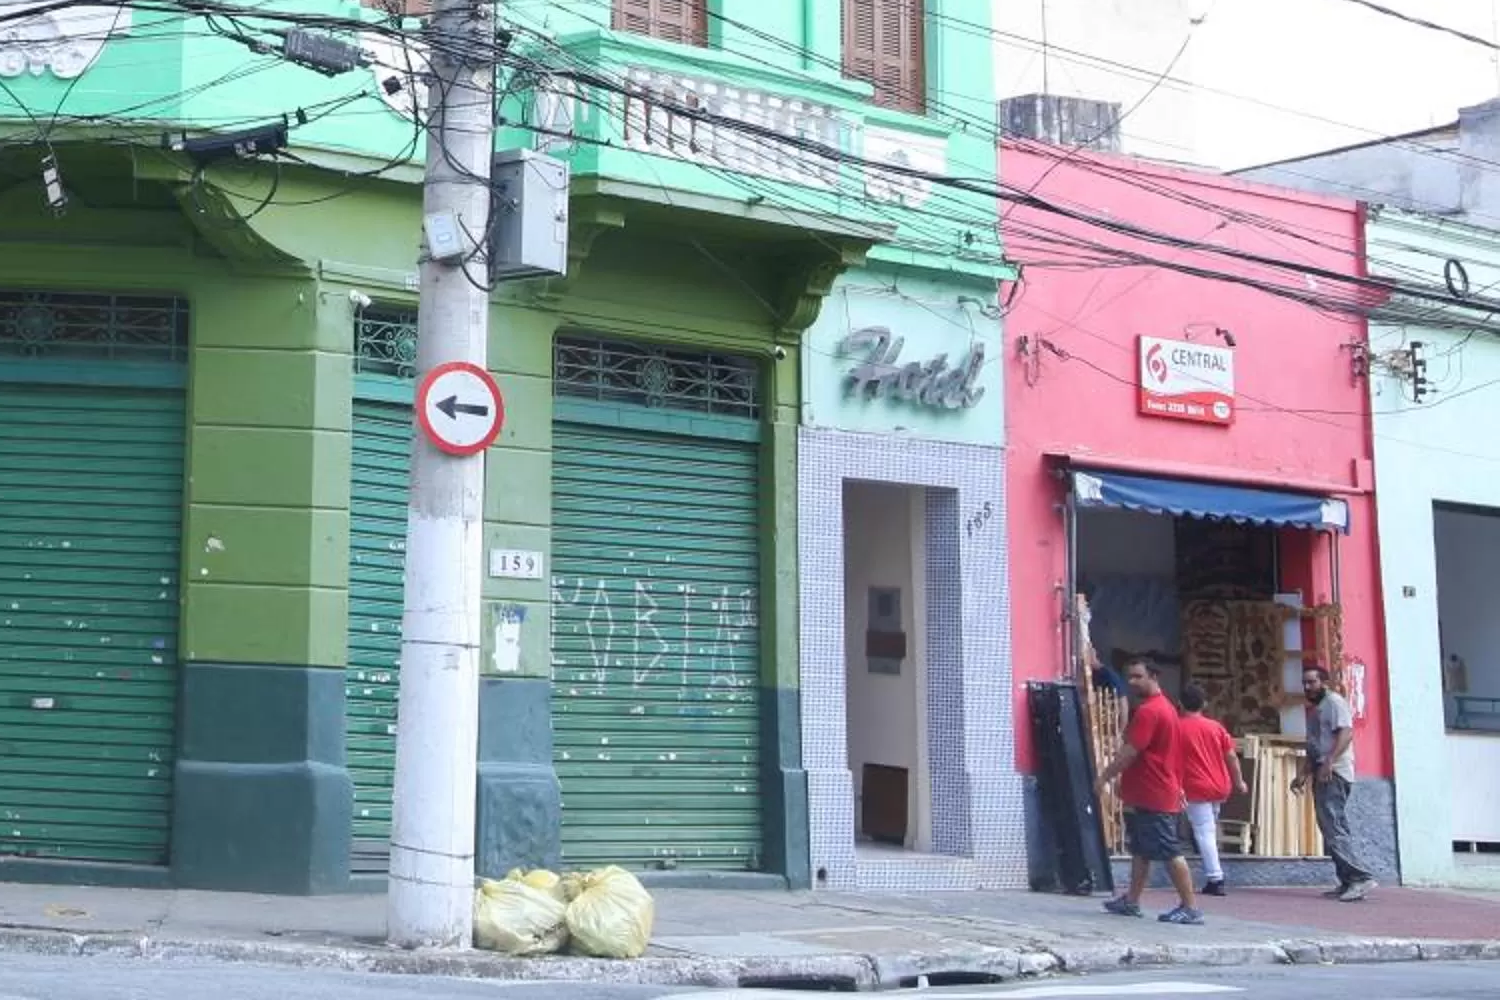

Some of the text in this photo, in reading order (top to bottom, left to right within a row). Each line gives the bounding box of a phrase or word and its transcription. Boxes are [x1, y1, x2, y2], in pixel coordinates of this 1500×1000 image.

[838, 325, 985, 409] Hotel
[1171, 348, 1227, 372] CENTRAL
[500, 555, 536, 571] 159
